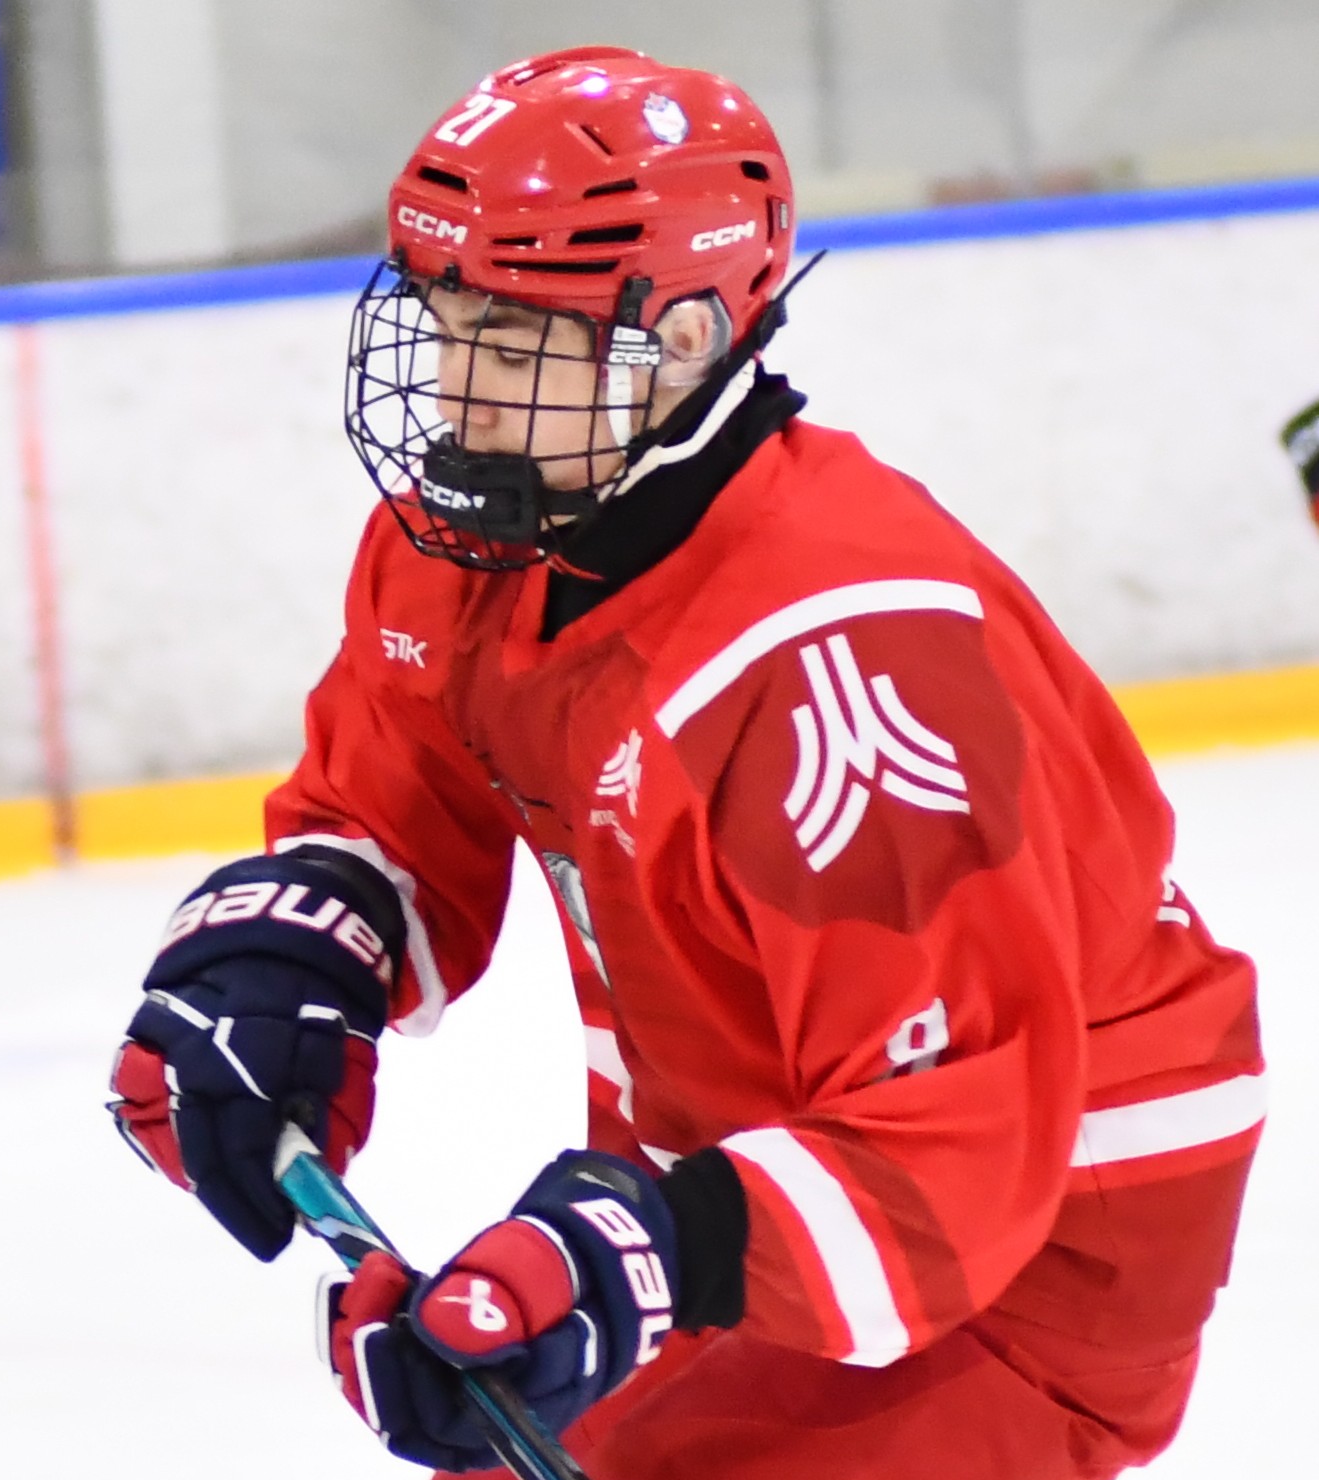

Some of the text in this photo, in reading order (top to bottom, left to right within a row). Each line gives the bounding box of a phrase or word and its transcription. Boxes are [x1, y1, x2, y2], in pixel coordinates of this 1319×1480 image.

[435, 94, 516, 146] 27
[396, 206, 468, 244] CCM
[690, 220, 756, 252] CCM
[608, 350, 660, 365] CCM
